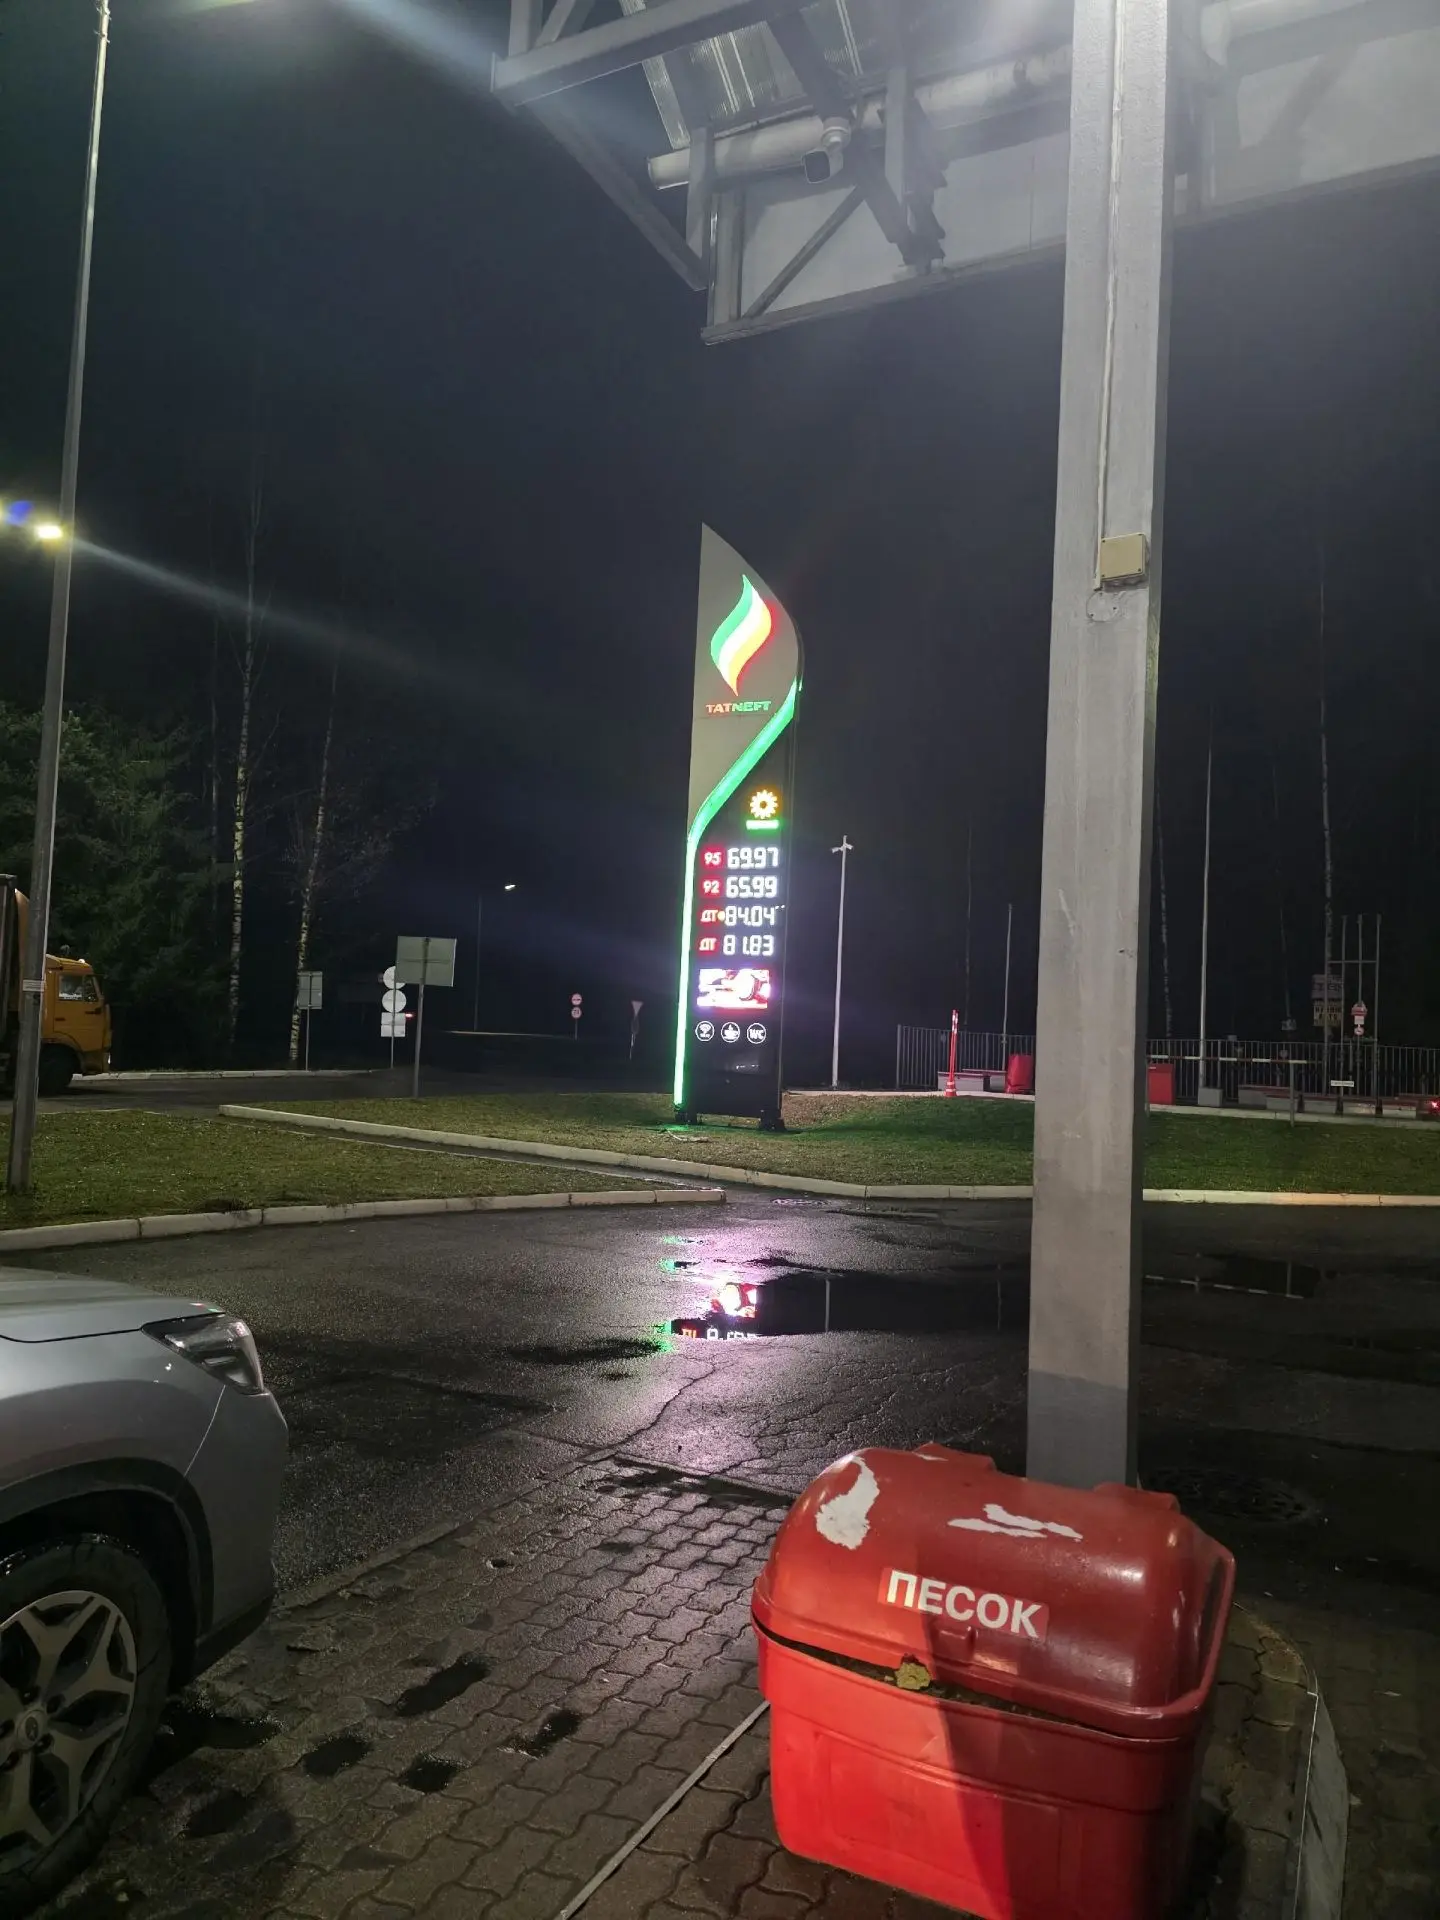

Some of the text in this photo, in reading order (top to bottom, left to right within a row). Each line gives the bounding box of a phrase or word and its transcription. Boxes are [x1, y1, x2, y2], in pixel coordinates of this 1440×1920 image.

[706, 701, 771, 713] TATNEFT
[704, 851, 722, 865] 95
[703, 880, 720, 894] 92
[700, 905, 775, 927] ДТ 84.04
[699, 937, 717, 951] ДТ
[749, 1028, 765, 1040] WC
[887, 1569, 1042, 1639] ПЕСОК
